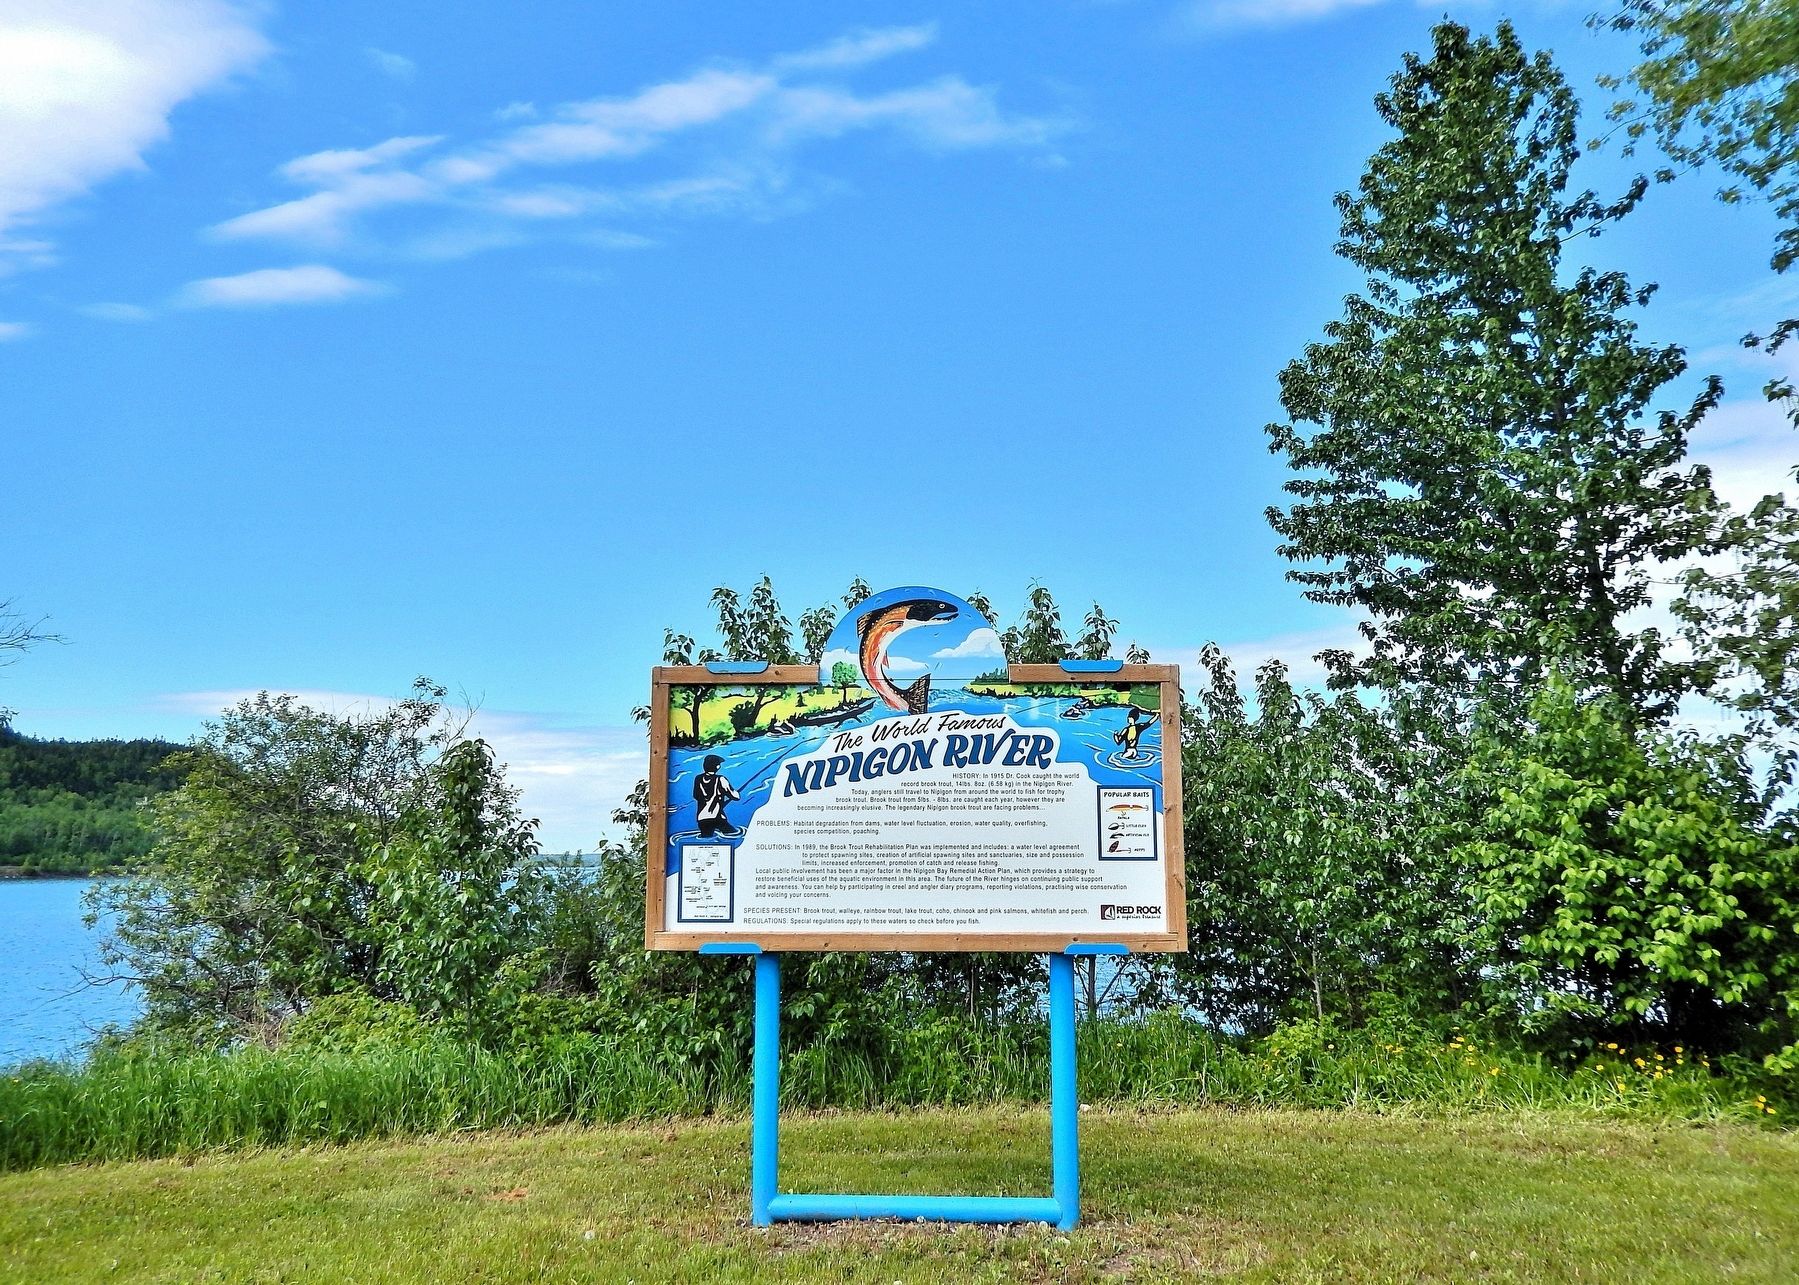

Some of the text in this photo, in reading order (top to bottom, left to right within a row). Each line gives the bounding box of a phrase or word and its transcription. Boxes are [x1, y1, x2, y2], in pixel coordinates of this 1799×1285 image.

[834, 714, 1006, 752] The World Famous
[784, 728, 1054, 797] NIPIGON RIVER
[1032, 772, 1052, 780] caught
[1033, 780, 1056, 788] Nipigon
[871, 788, 892, 796] anglers
[930, 788, 952, 796] Nipigon
[1046, 788, 1065, 796] trophy
[964, 796, 983, 804] caught
[797, 804, 824, 812] becoming
[826, 804, 860, 812] increasingly
[897, 804, 925, 812] legendary
[926, 804, 949, 812] Nipigon
[994, 804, 1012, 812] facing
[815, 820, 849, 828] degradation
[794, 827, 815, 836] species
[933, 843, 970, 852] implemented
[1049, 843, 1080, 852] agreement
[809, 851, 830, 860] protect
[831, 851, 858, 860] spawning
[933, 851, 960, 860] spawning
[1052, 851, 1084, 860] possession
[888, 859, 918, 868] promotion
[772, 867, 790, 875] public
[913, 867, 935, 875] Nipigon
[936, 867, 948, 875] Bay
[1032, 867, 1057, 875] provides
[1064, 867, 1088, 875] strategy
[840, 875, 860, 883] aquatic
[1000, 875, 1020, 883] hinges
[1030, 875, 1060, 883] continuing
[1062, 875, 1079, 883] public
[1081, 875, 1102, 883] support
[848, 883, 884, 891] participating
[920, 883, 938, 891] angler
[940, 883, 954, 891] diary
[986, 883, 1012, 891] reporting
[1045, 883, 1074, 891] practising
[768, 891, 788, 899] voicing
[990, 907, 1002, 915] pink
[1116, 906, 1161, 914] RED ROCK
[790, 918, 812, 926] Special
[812, 918, 844, 926] regulations
[846, 918, 862, 926] apply
